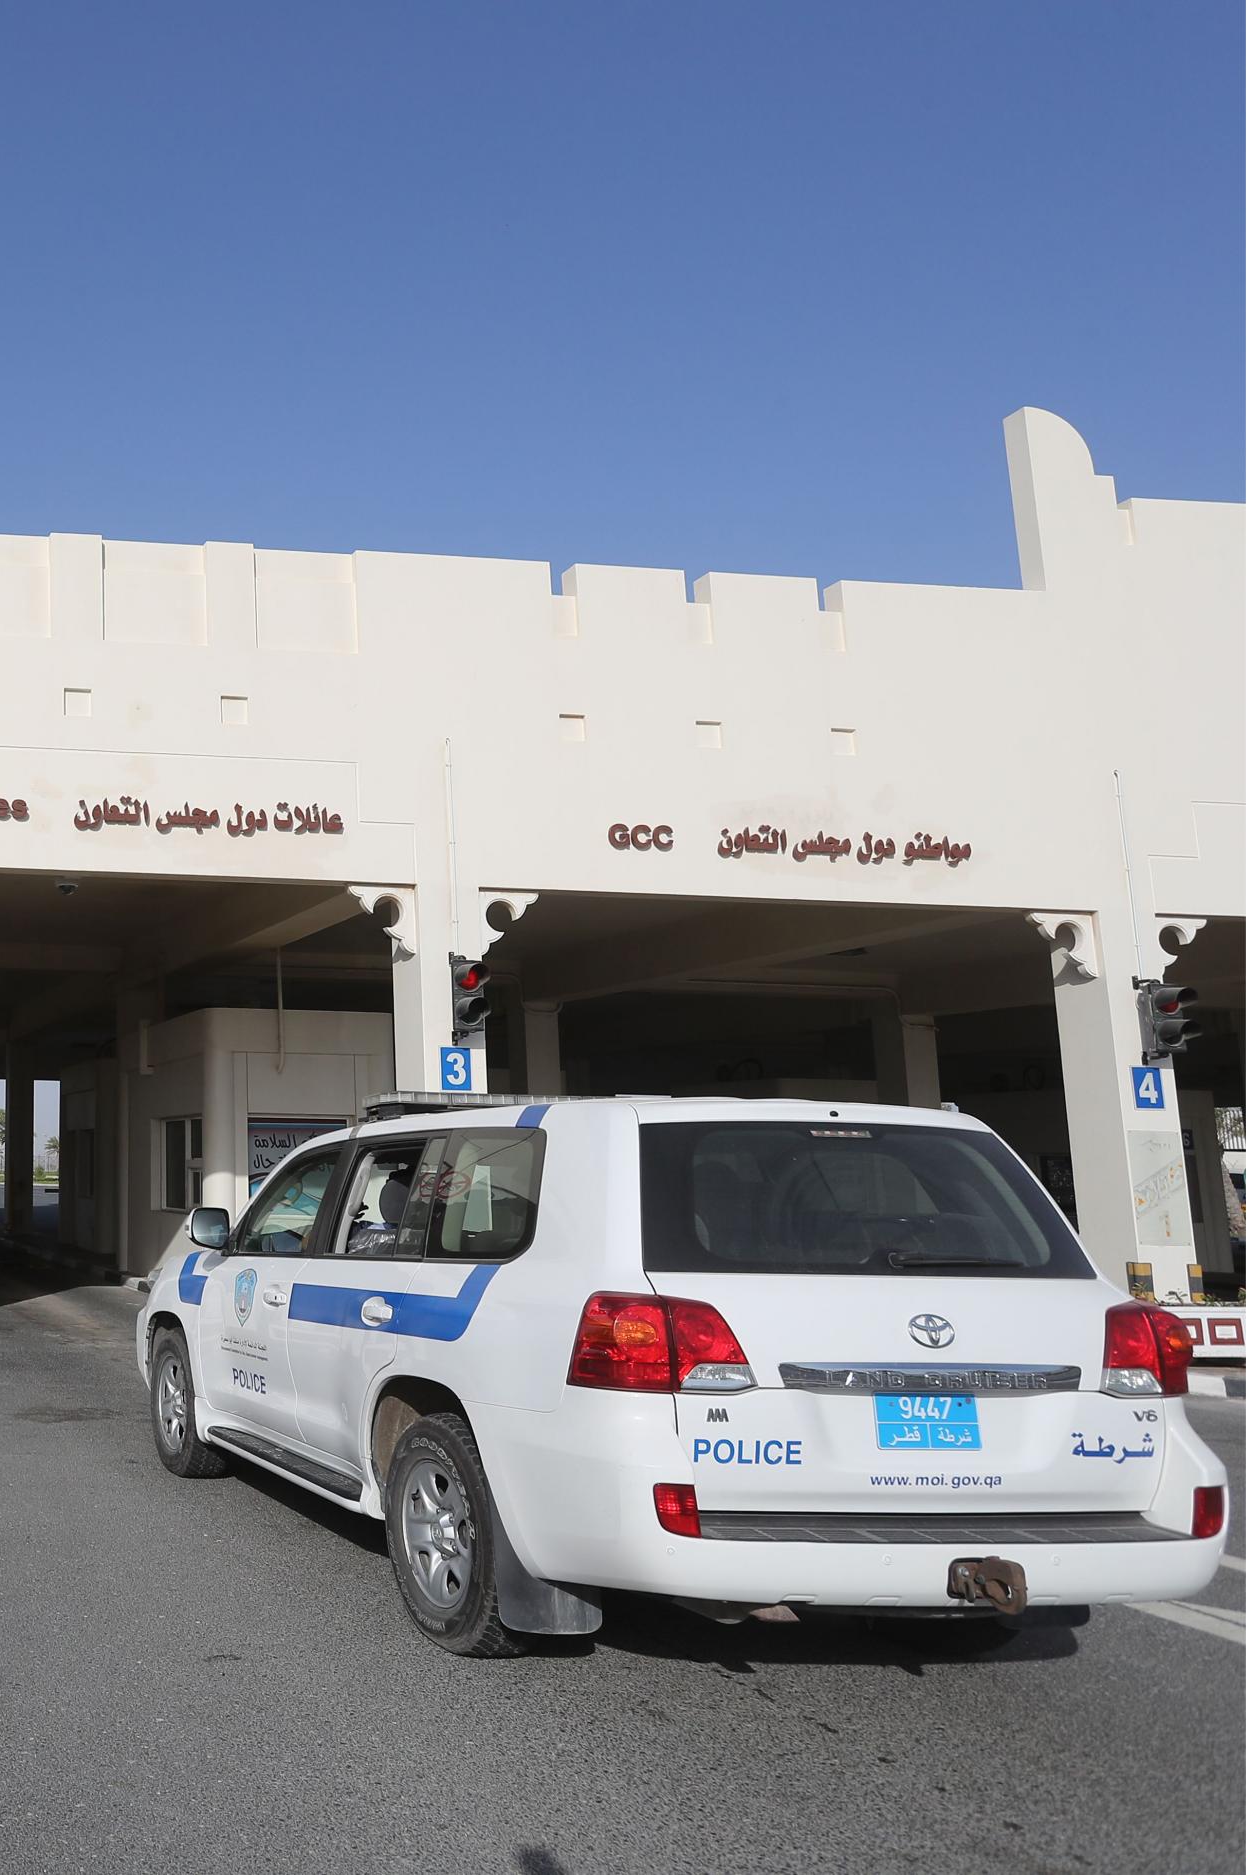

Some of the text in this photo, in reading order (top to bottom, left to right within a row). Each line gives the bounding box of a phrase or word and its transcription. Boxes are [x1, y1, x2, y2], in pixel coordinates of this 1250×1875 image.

[73, 795, 344, 837] عائلات دول مجلس التعاون
[608, 823, 674, 851] GCC
[717, 824, 971, 868] مواطنو دول مجلس التعاون
[446, 1052, 466, 1086] 3
[1138, 1072, 1159, 1104] 4
[232, 1367, 266, 1394] POLICE
[825, 1370, 1047, 1388] LAND CRUISER
[898, 1397, 951, 1420] 9447
[1132, 1409, 1158, 1422] V6
[888, 1425, 972, 1446] شرطة قطر
[1071, 1432, 1155, 1464] شرطة
[693, 1438, 802, 1465] POLICE
